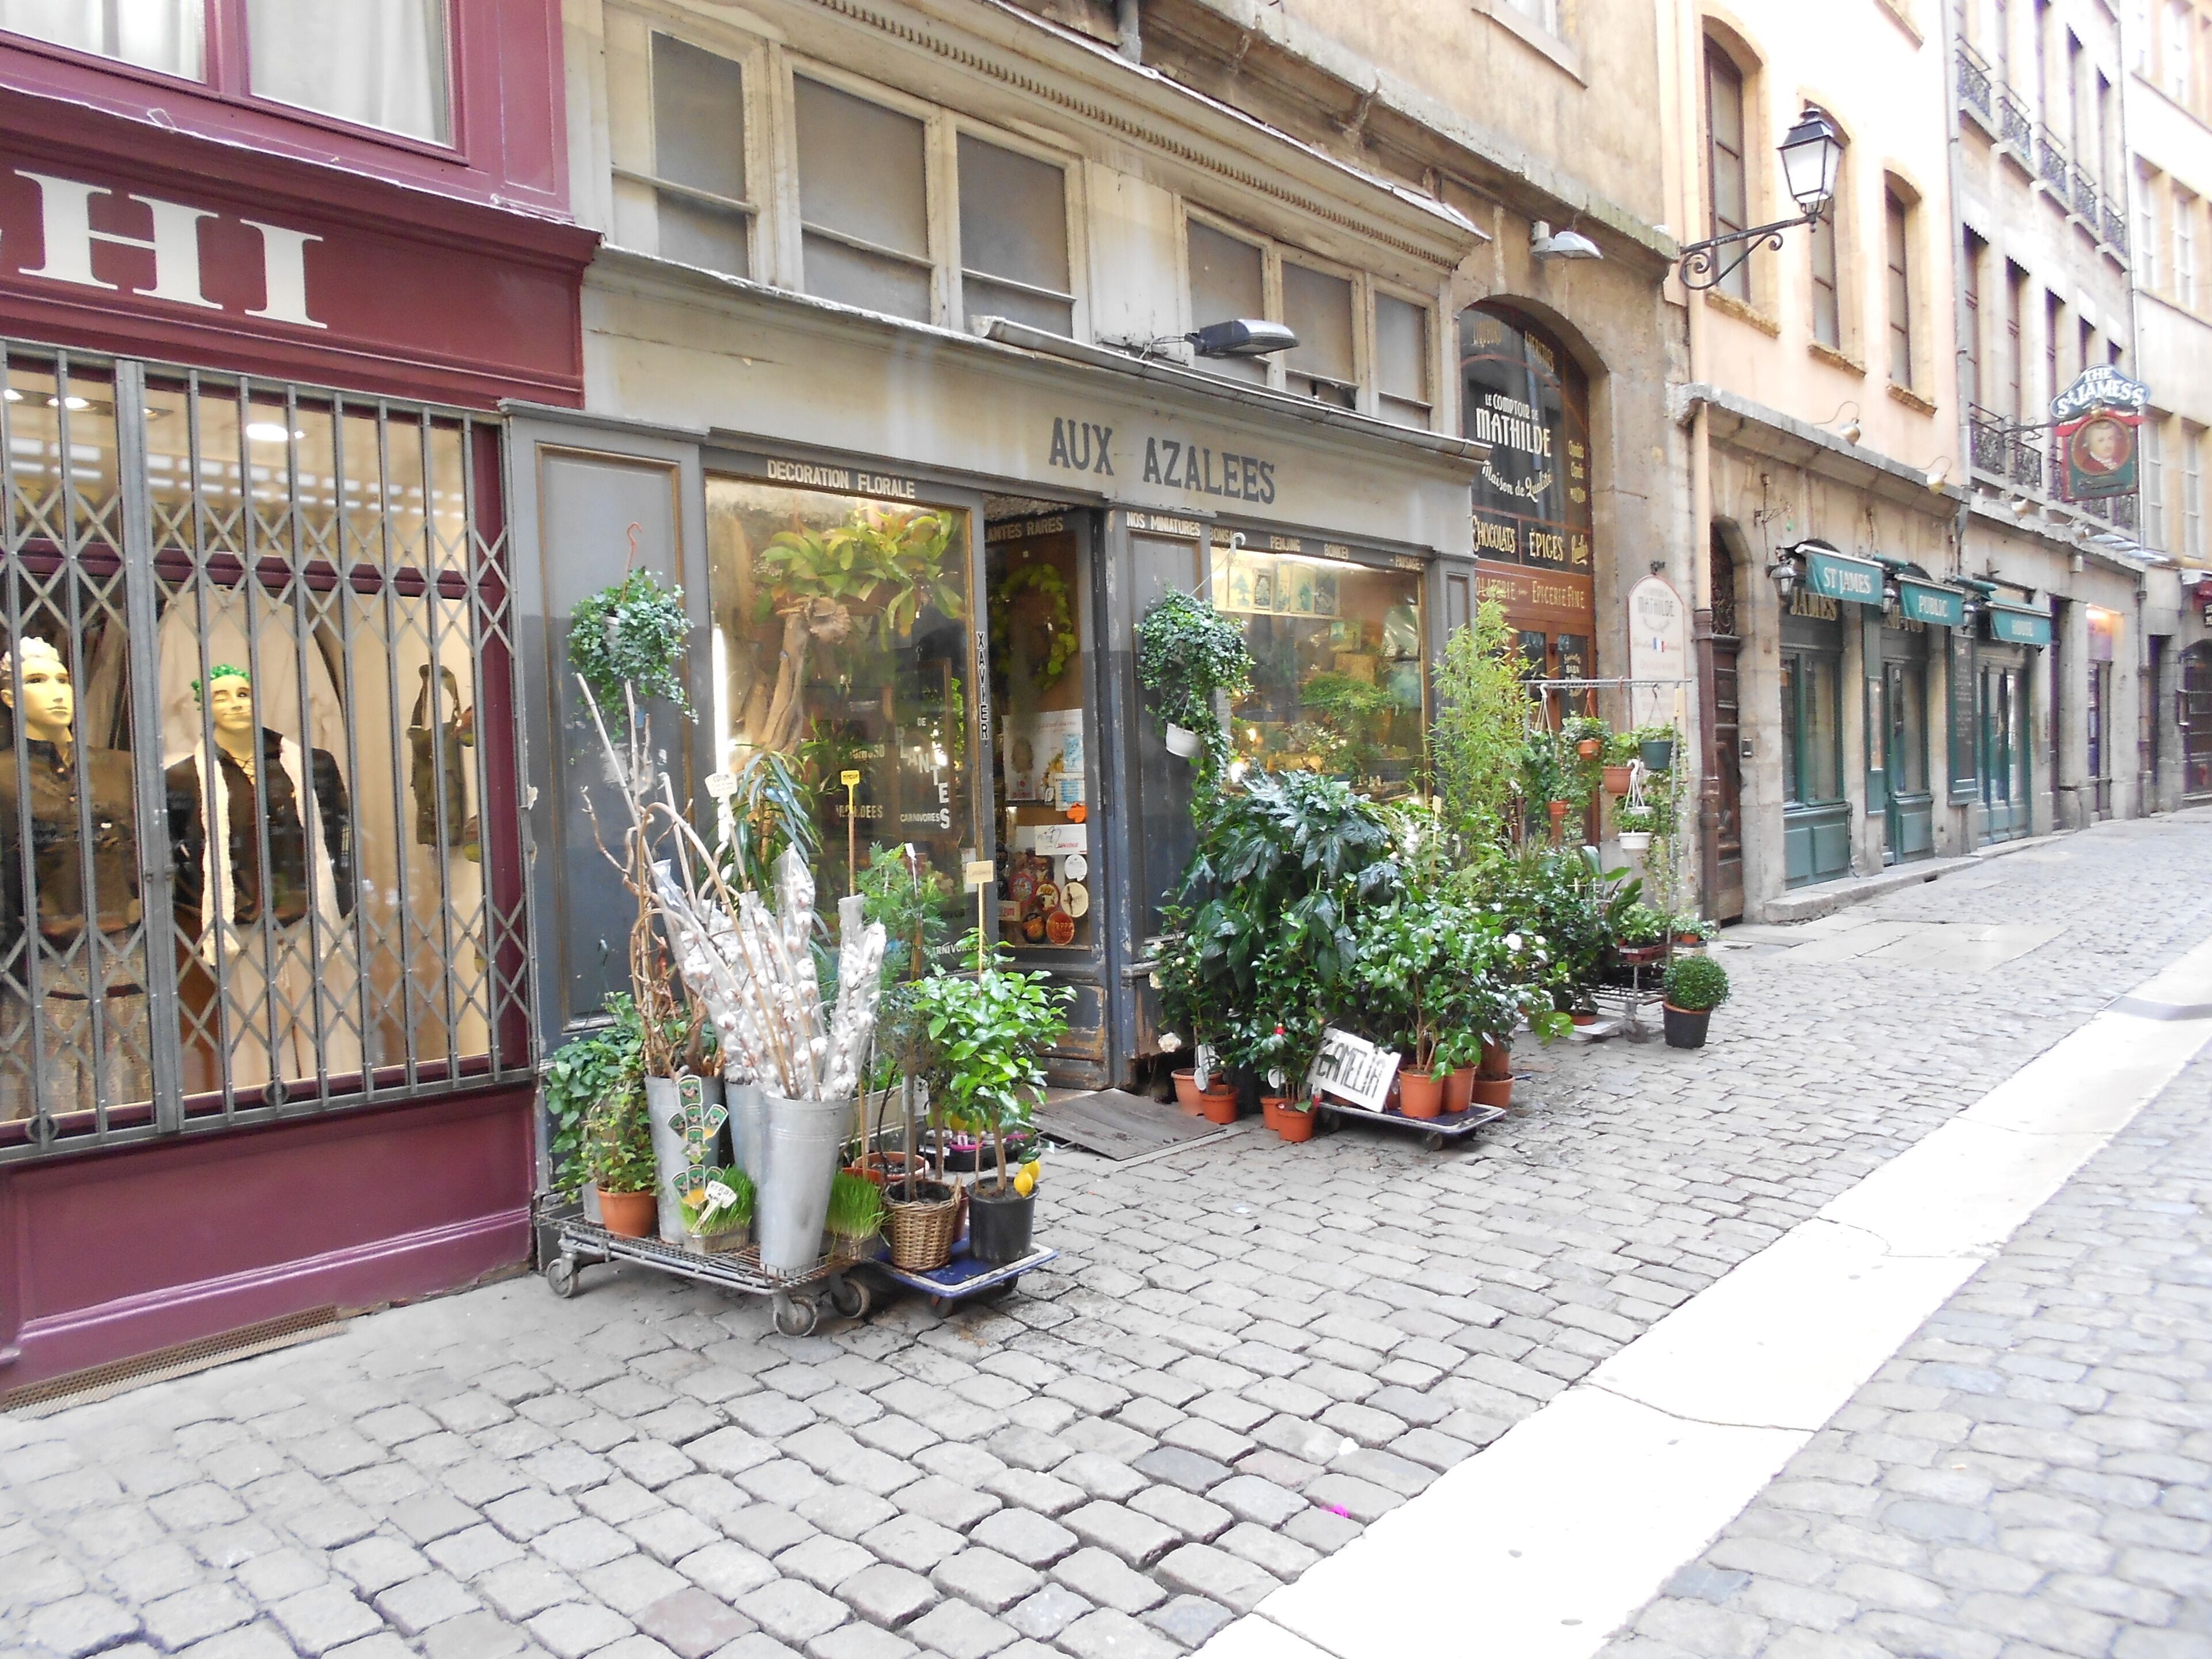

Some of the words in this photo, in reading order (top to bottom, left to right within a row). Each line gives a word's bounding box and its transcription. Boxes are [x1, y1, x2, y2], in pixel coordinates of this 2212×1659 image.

[10, 168, 328, 329] HI
[2084, 367, 2113, 382] THE
[1484, 393, 1493, 407] LE
[1493, 393, 1530, 419] COMPTOIR
[1476, 407, 1551, 458] MATHILDE
[1048, 417, 1114, 476] AUX
[1143, 437, 1275, 505] AZALEES
[767, 460, 849, 490] DECORATION
[858, 473, 915, 499] FLORALE
[1482, 460, 1513, 495] Maison
[1515, 479, 1525, 497] de
[1525, 468, 1553, 503] Qualité
[1027, 517, 1064, 536] RARES
[1126, 512, 1146, 529] NOS
[1150, 515, 1200, 537] MINIATURES
[1210, 528, 1236, 543] BONSA
[1471, 514, 1516, 554] CHOCOLATS
[1529, 528, 1563, 562] ÉPICES
[1823, 566, 1837, 589] ST
[1839, 569, 1871, 594] JAMES
[1638, 596, 1675, 617] MATHILDE
[1918, 594, 1949, 618] PUBLIC
[976, 631, 989, 740] XAVIER
[917, 717, 927, 726] DE
[895, 726, 950, 829] PLANTES
[900, 813, 940, 823] CARNIVORES
